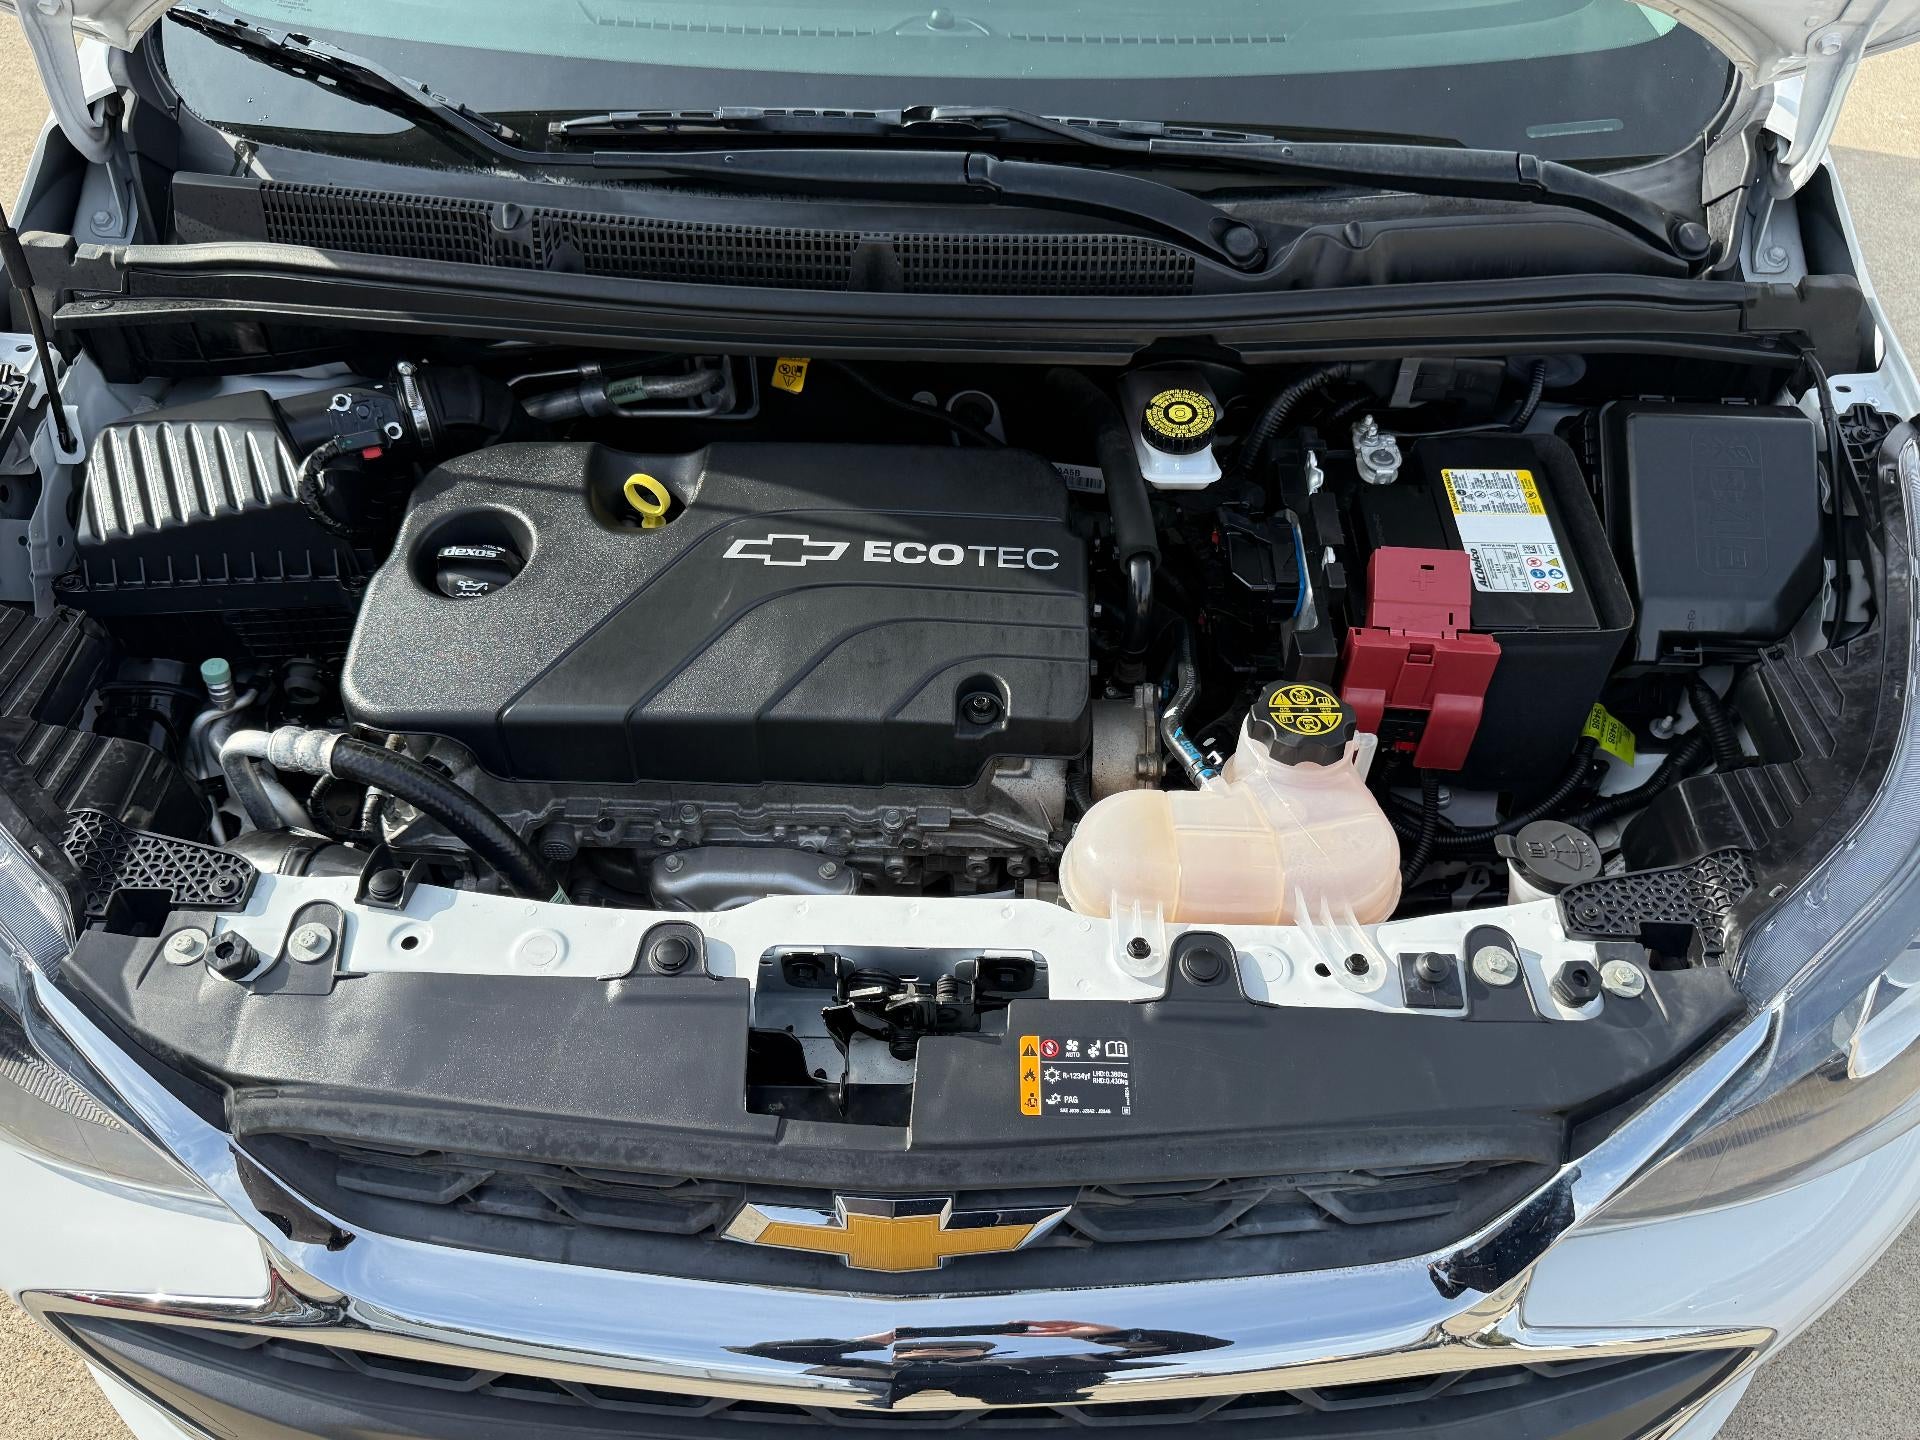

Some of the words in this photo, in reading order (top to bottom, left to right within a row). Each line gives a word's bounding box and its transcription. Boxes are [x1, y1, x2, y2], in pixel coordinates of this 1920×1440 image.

[443, 546, 497, 557] dexos
[862, 540, 1060, 570] ECOTEC
[1471, 549, 1488, 587] ACDelco
[1062, 1072, 1091, 1081] R-1234yf
[1063, 1095, 1079, 1104] PAG
